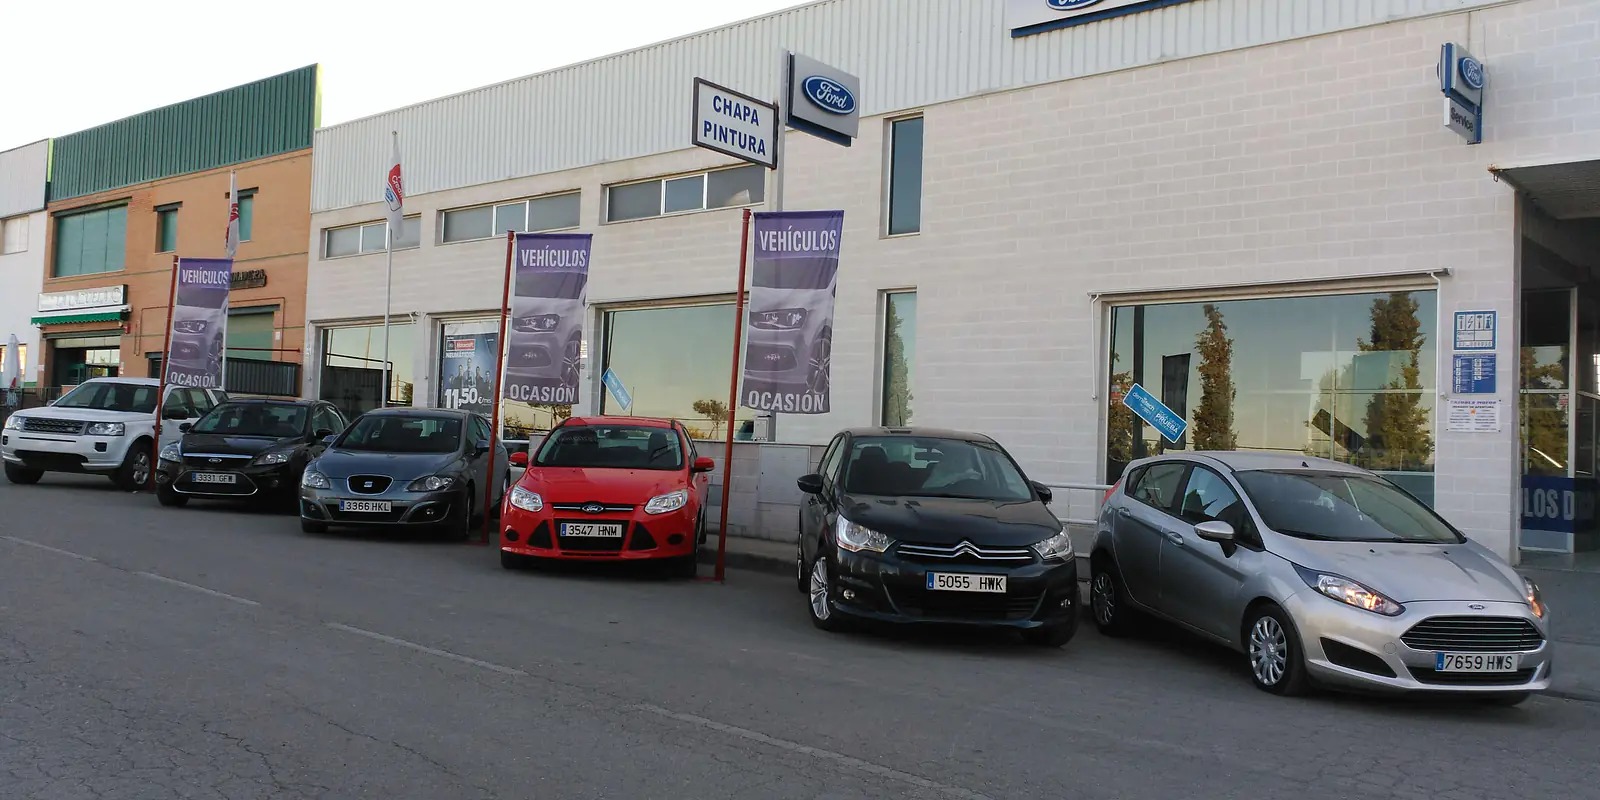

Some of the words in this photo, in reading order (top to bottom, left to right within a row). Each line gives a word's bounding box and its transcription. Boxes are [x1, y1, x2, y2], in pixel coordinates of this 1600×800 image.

[816, 81, 847, 109] Ford
[713, 95, 759, 127] CHAPA
[1450, 106, 1474, 132] Service
[703, 120, 766, 156] PINTURA
[759, 225, 837, 252] VEHÍCULOS
[521, 245, 587, 268] VEHÍCULOS
[182, 266, 229, 285] VEHÍCULOS
[171, 371, 216, 387] OCASIÓN
[509, 383, 576, 402] OCASIÓN
[748, 389, 825, 412] OCASIÓN
[1155, 413, 1178, 434] PRUEBA
[346, 501, 370, 511] 3366
[371, 502, 390, 512] HKL
[1521, 488, 1559, 519] LOS
[568, 525, 594, 536] 3547
[598, 526, 617, 536] HNM
[938, 575, 970, 589] 5055
[979, 577, 1004, 591] HWK
[1445, 655, 1483, 670] 7659
[1486, 656, 1513, 670] HWS
